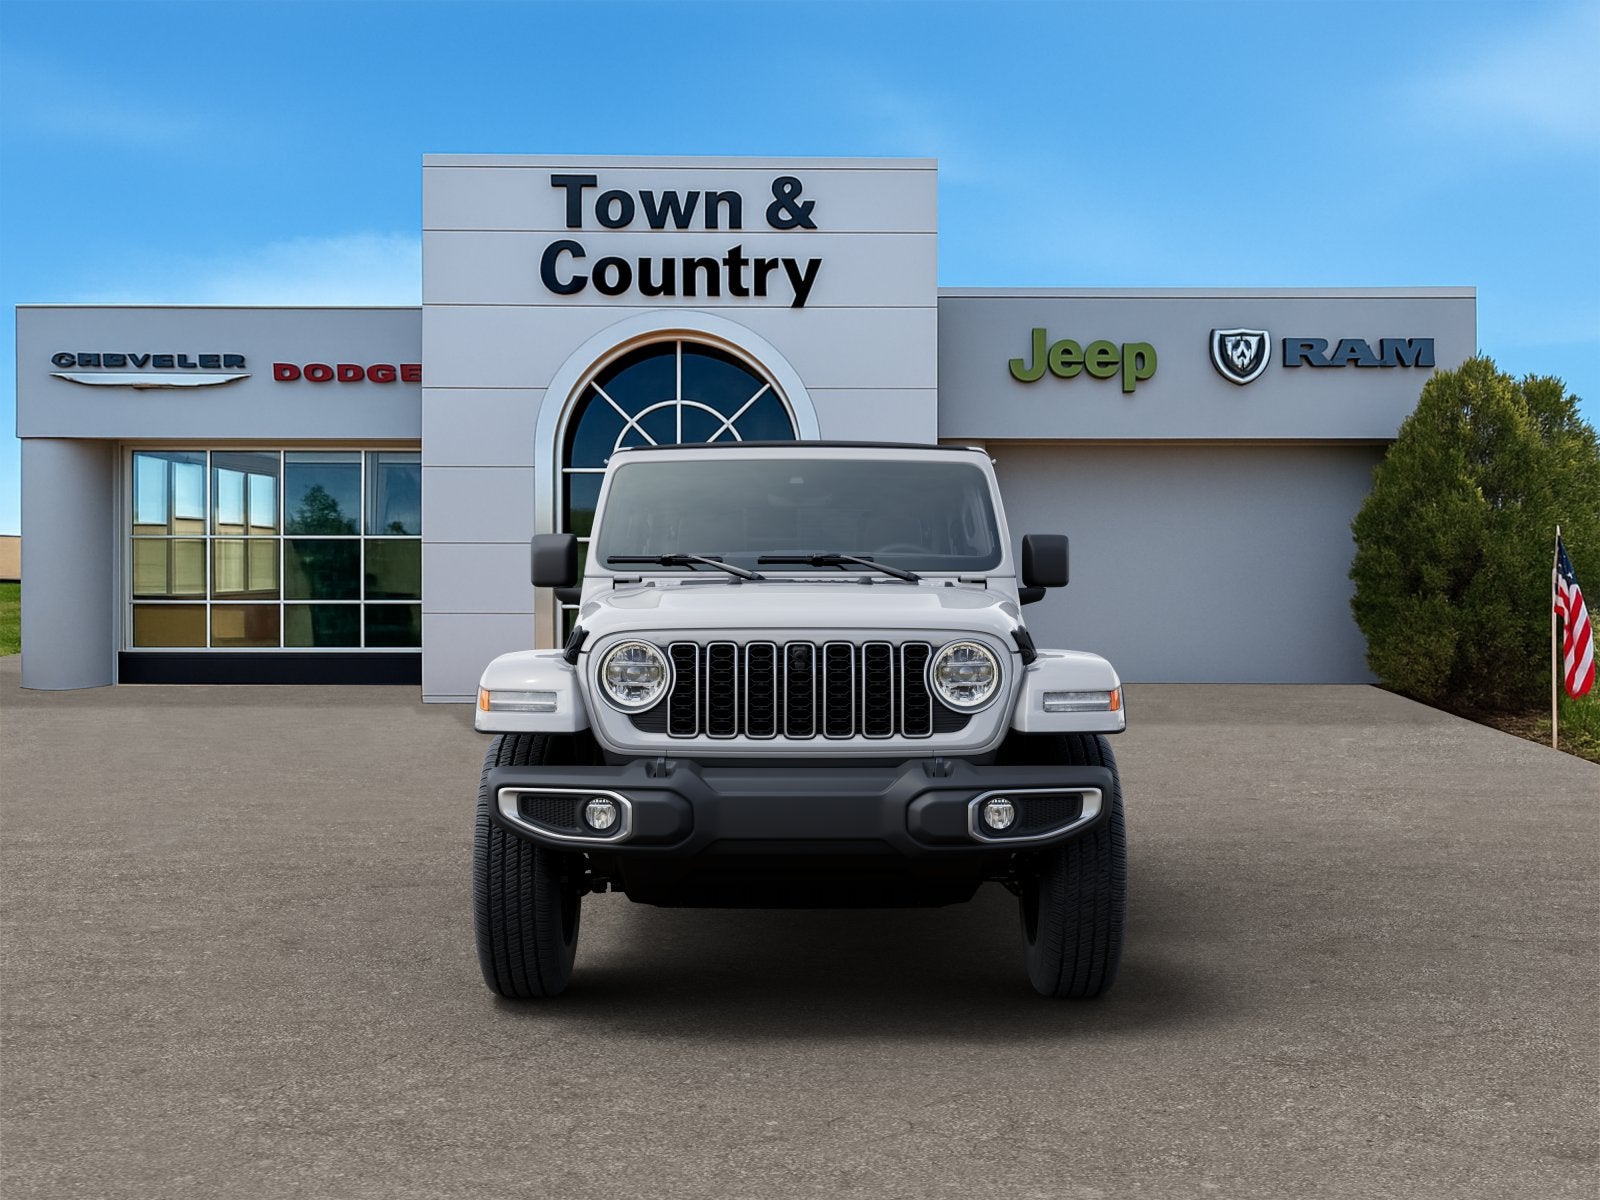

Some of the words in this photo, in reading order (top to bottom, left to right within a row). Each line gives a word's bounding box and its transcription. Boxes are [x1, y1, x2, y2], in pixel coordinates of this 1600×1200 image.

[550, 174, 743, 230] Town
[765, 175, 818, 230] &
[540, 239, 822, 309] Country
[273, 362, 422, 383] DODGE
[1009, 327, 1158, 393] Jeep
[1283, 337, 1435, 368] RAM
